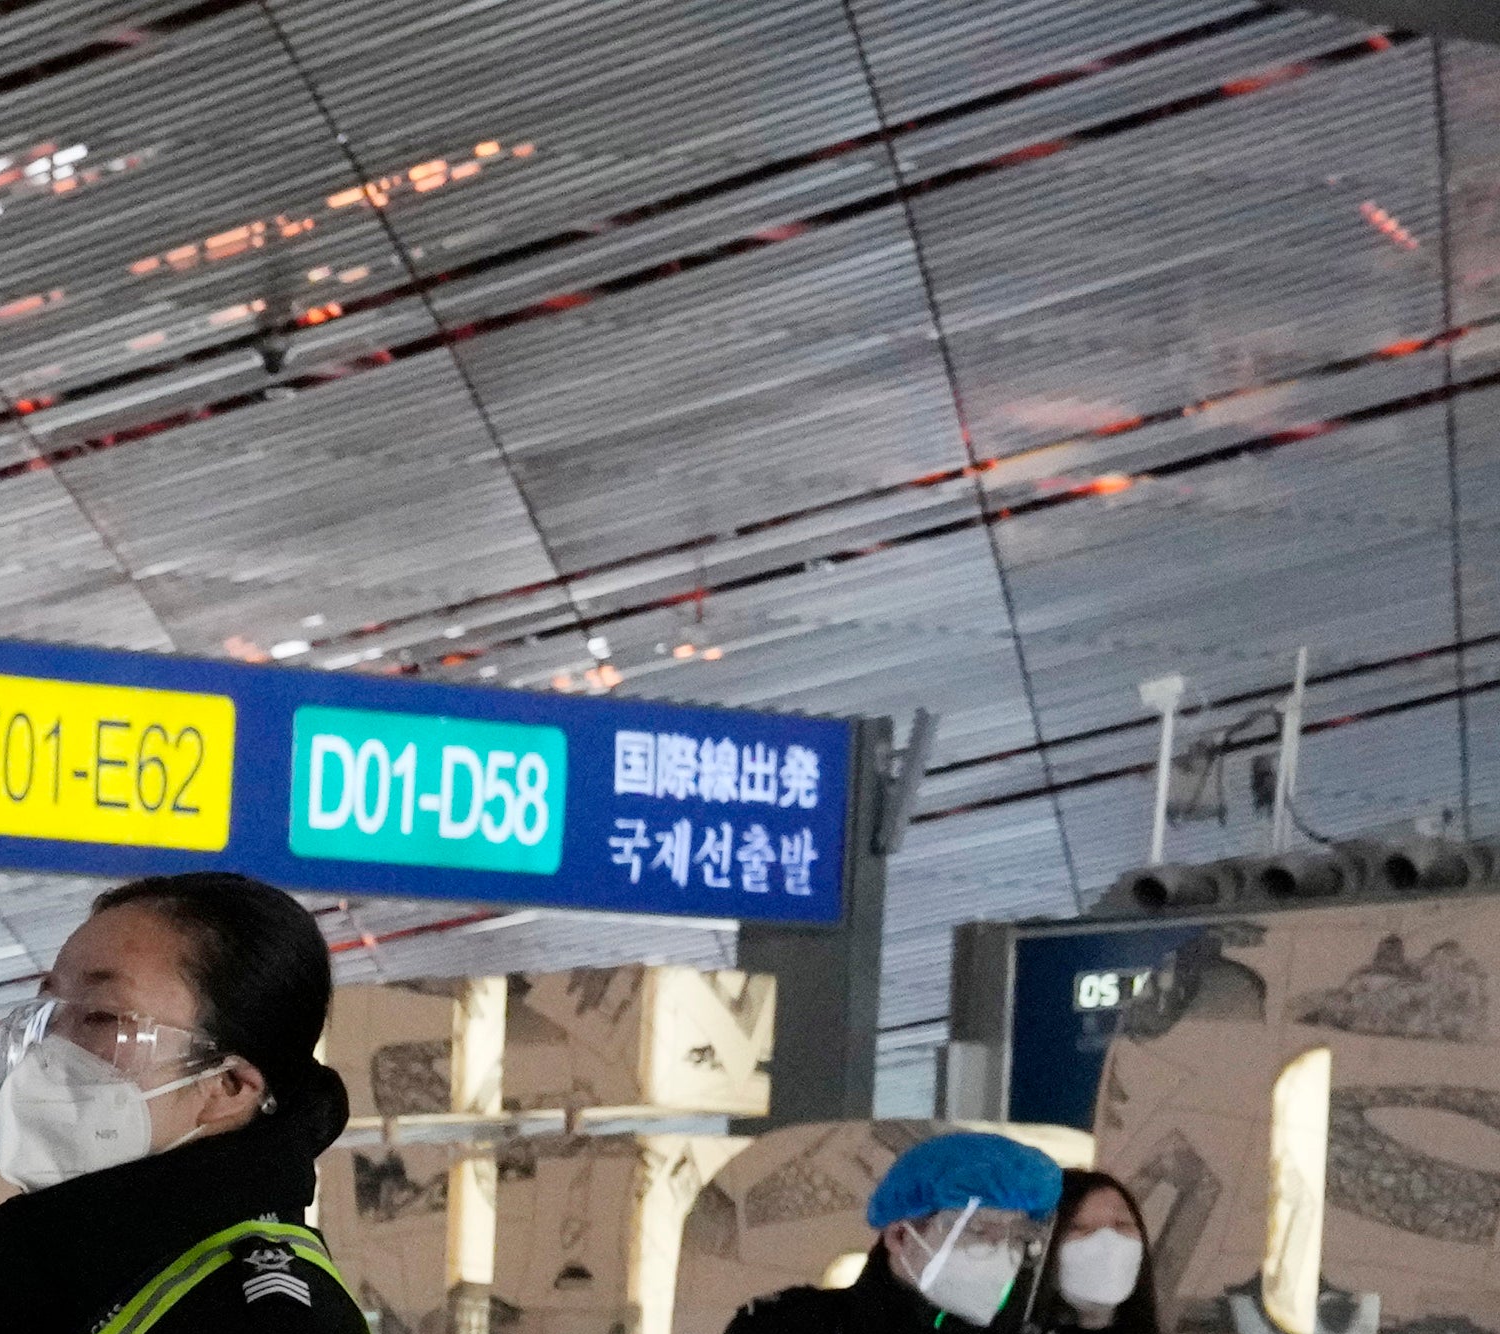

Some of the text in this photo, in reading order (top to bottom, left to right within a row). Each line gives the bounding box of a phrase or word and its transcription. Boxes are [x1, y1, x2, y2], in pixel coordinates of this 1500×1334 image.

[308, 734, 550, 847] D01-D58
[614, 730, 820, 809] 国際線出発
[608, 818, 819, 896] 국제선출발
